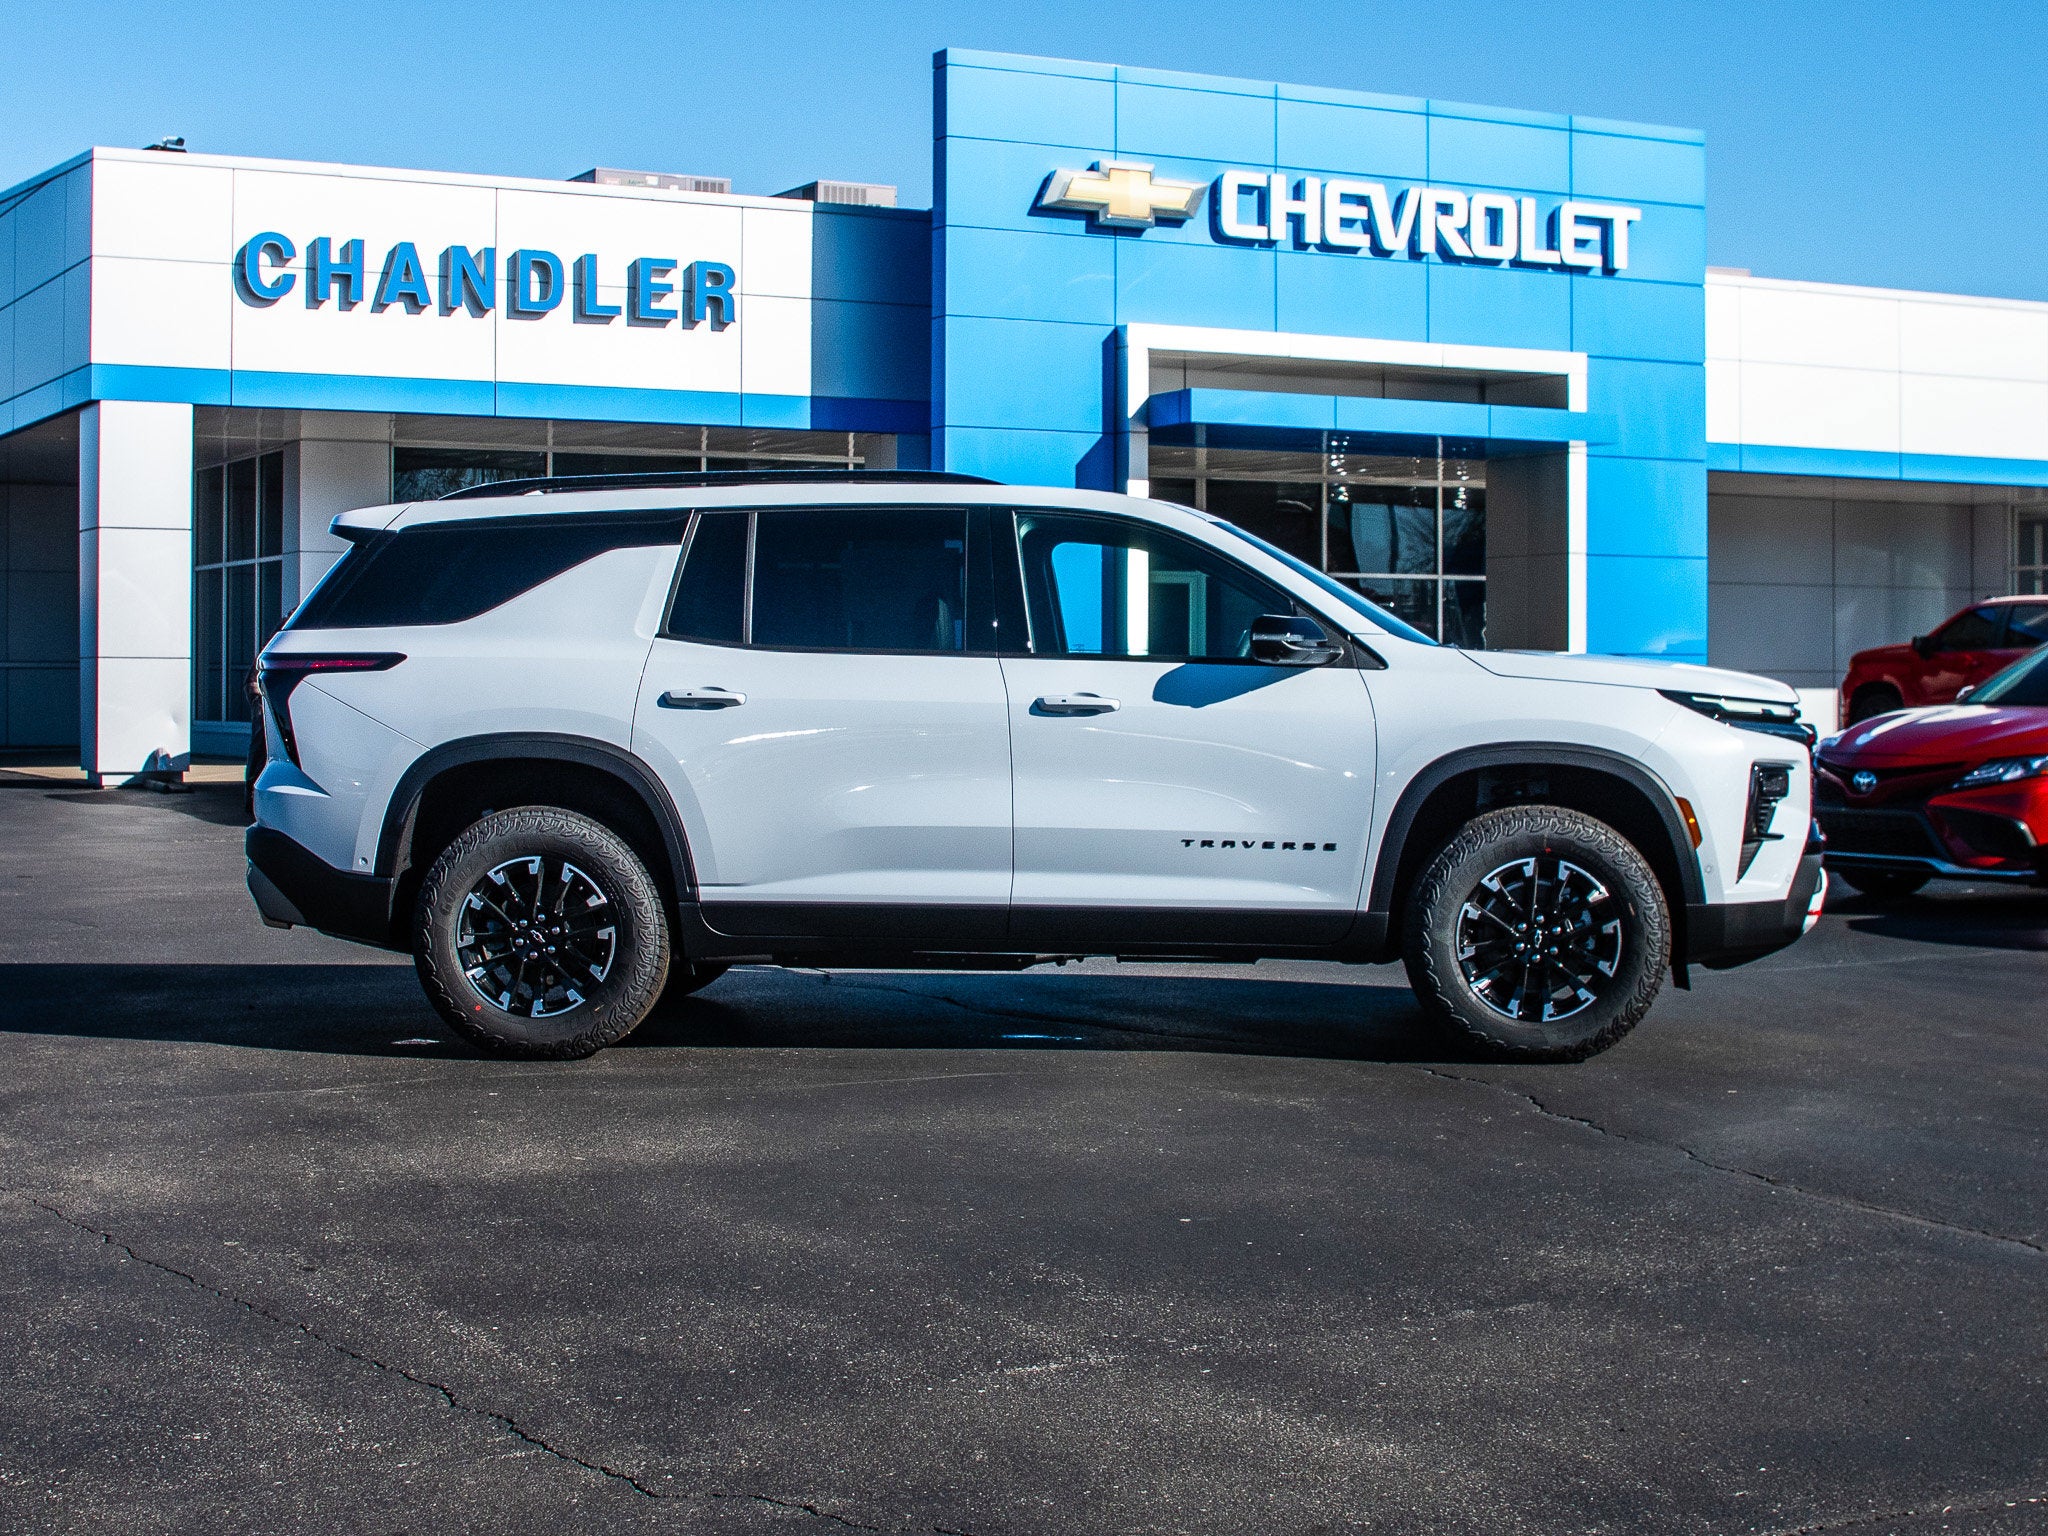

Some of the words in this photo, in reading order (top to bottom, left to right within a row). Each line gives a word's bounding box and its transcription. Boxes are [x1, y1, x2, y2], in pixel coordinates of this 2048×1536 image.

[1215, 169, 1642, 272] CHEVROLET
[236, 231, 737, 331] CHANDLER
[1180, 838, 1338, 852] TRAVERSE
